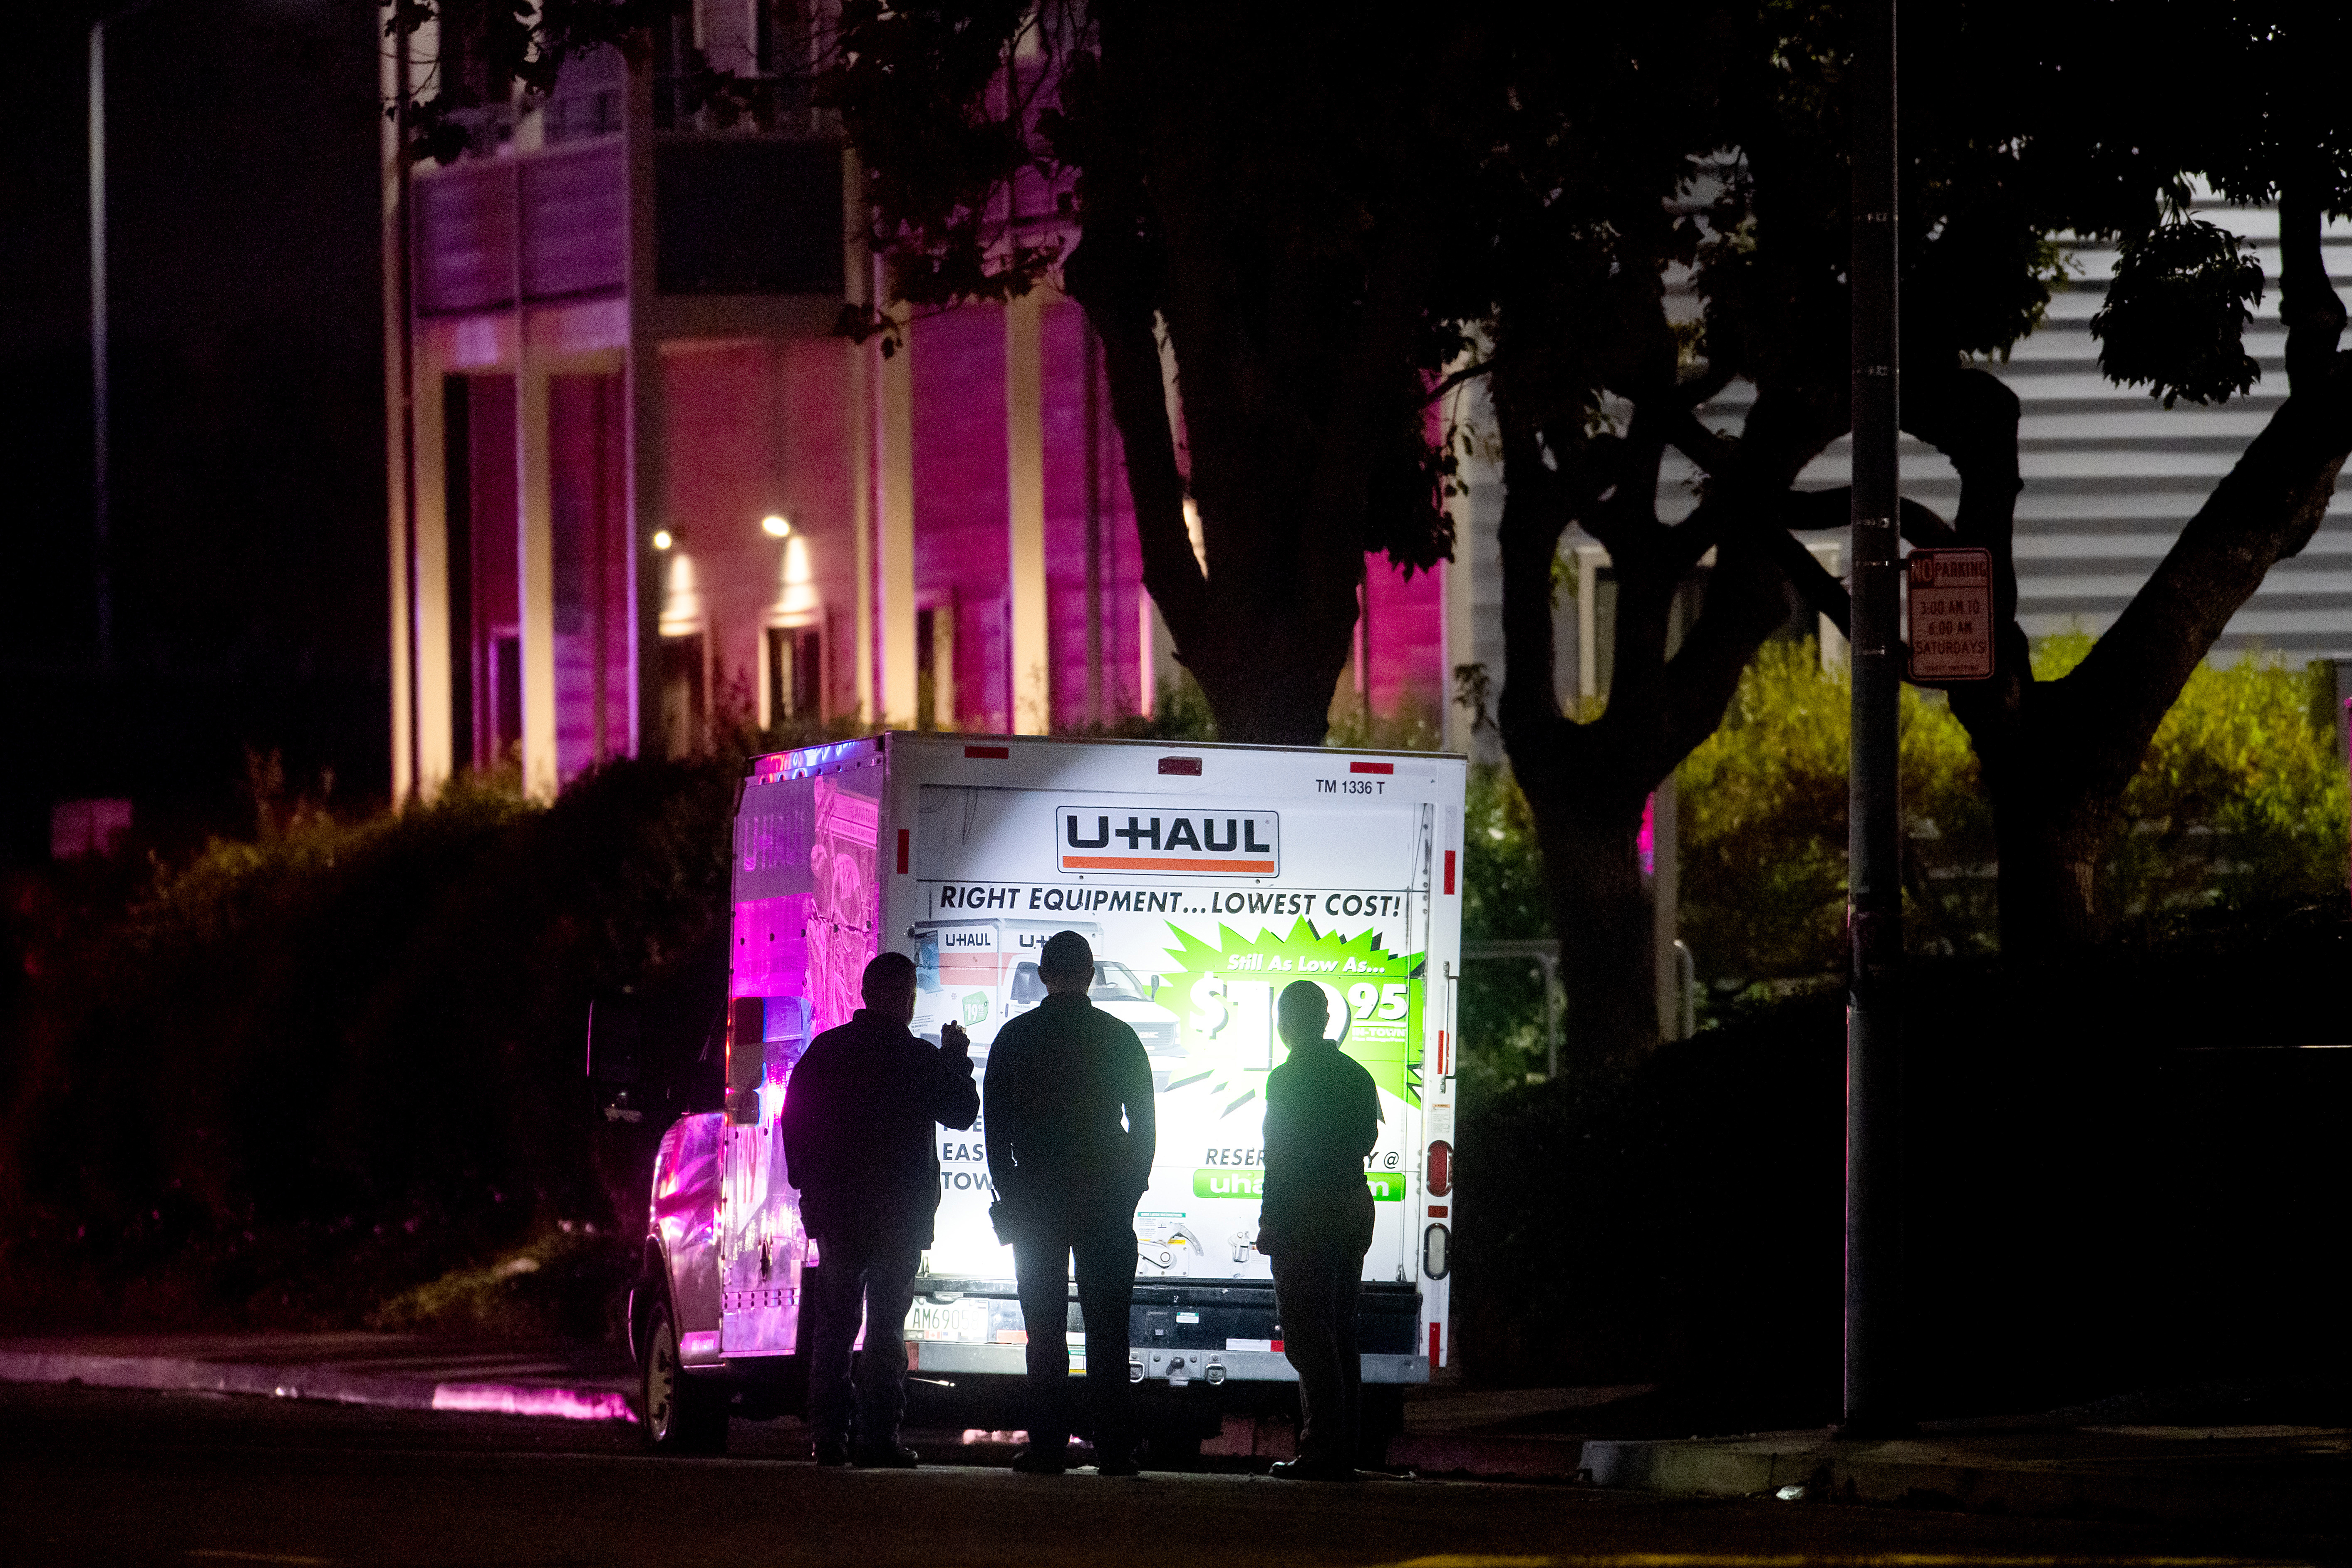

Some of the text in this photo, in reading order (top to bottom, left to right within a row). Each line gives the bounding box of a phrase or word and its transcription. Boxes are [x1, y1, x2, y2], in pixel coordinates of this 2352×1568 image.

[1911, 559, 1988, 582] NO PARKING
[1949, 600, 1963, 614] AM
[1968, 600, 1980, 614] TO
[1958, 621, 1973, 634] AM
[1915, 641, 1987, 654] SATURDAYS
[1316, 779, 1385, 795] TM 1336 T
[1067, 815, 1270, 853] U-HAUL
[940, 885, 1021, 909] RIGHT
[1325, 894, 1400, 917] COST!
[945, 933, 991, 947] U-HAUL
[1227, 953, 1263, 971] Still
[1268, 955, 1292, 972] As
[1298, 956, 1338, 973] Low
[1352, 1028, 1405, 1037] IN-TOWN
[943, 1142, 984, 1161] EAS
[1205, 1148, 1264, 1166] RESER
[1384, 1152, 1399, 1169] @
[912, 1308, 979, 1330] AM69058
